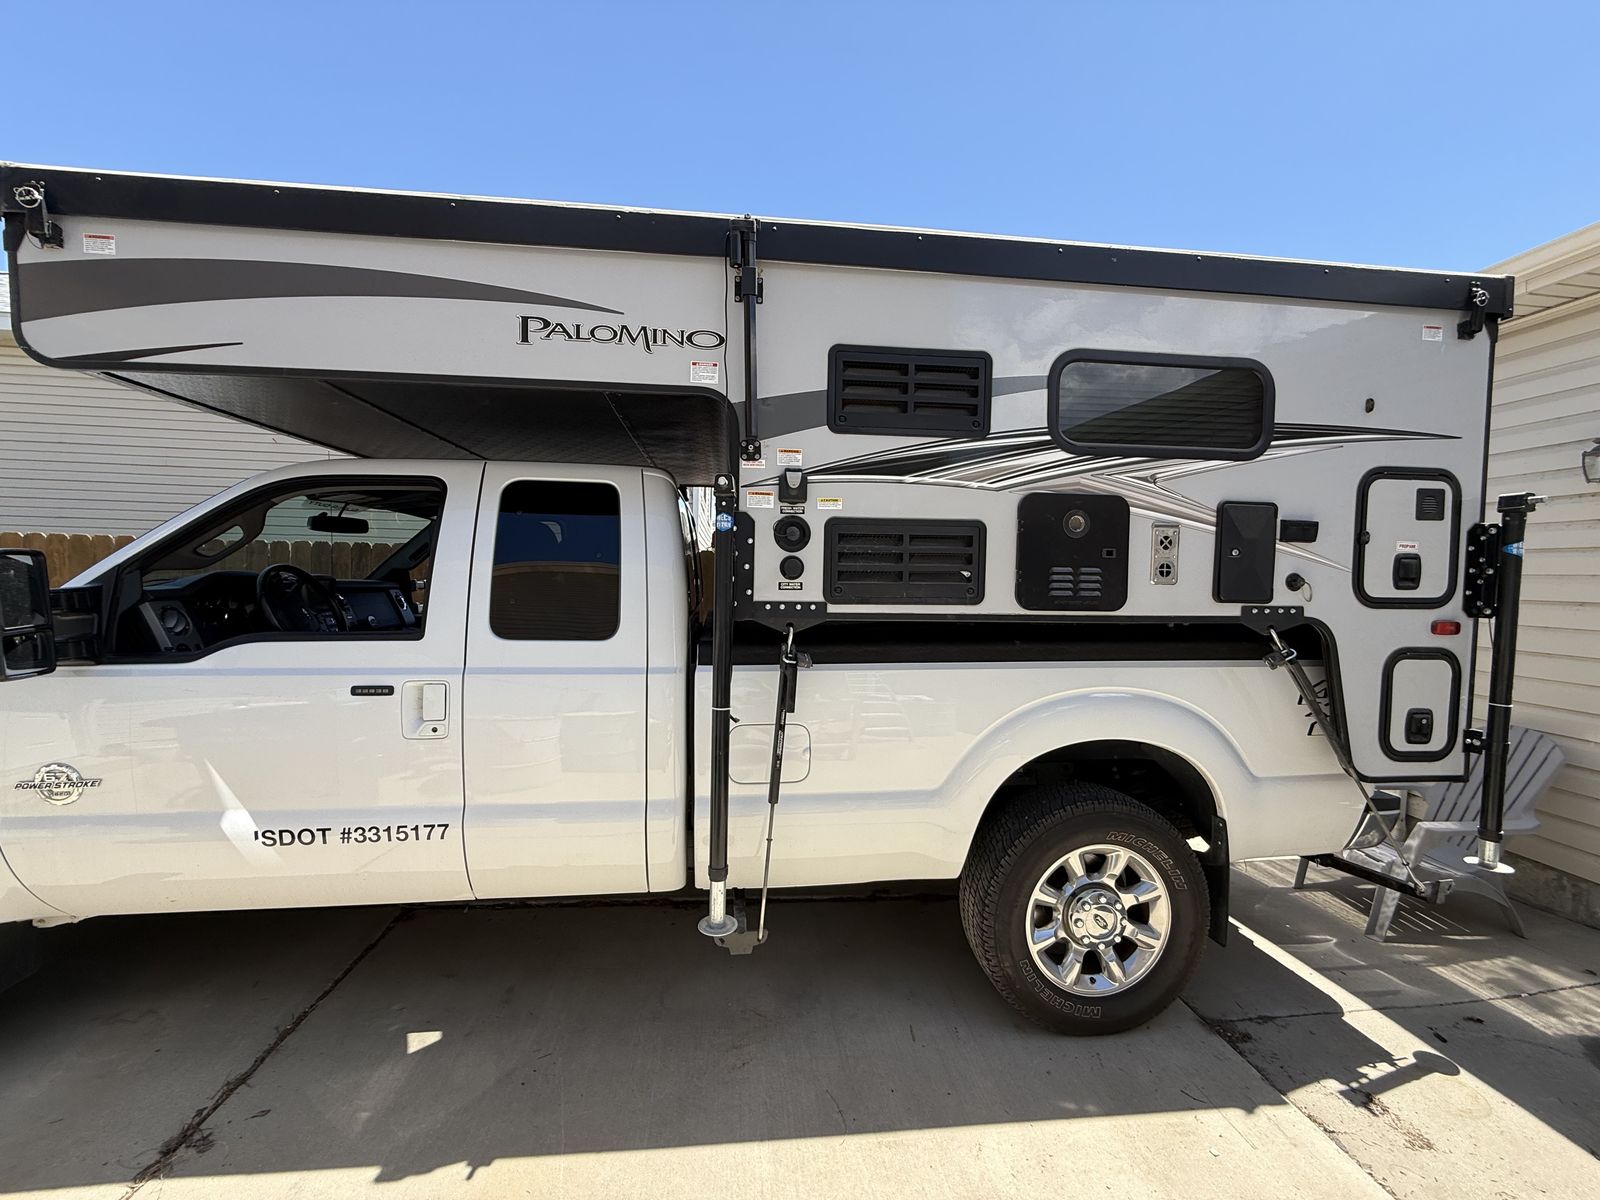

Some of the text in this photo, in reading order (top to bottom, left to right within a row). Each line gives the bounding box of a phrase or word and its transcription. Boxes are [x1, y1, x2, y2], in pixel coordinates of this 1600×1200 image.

[515, 314, 727, 354] PALOMINO
[14, 780, 99, 790] POWER STROKE
[339, 823, 450, 844] #3315177
[1106, 831, 1188, 890] MICHELIN
[1020, 959, 1102, 1019] MICHELIN
